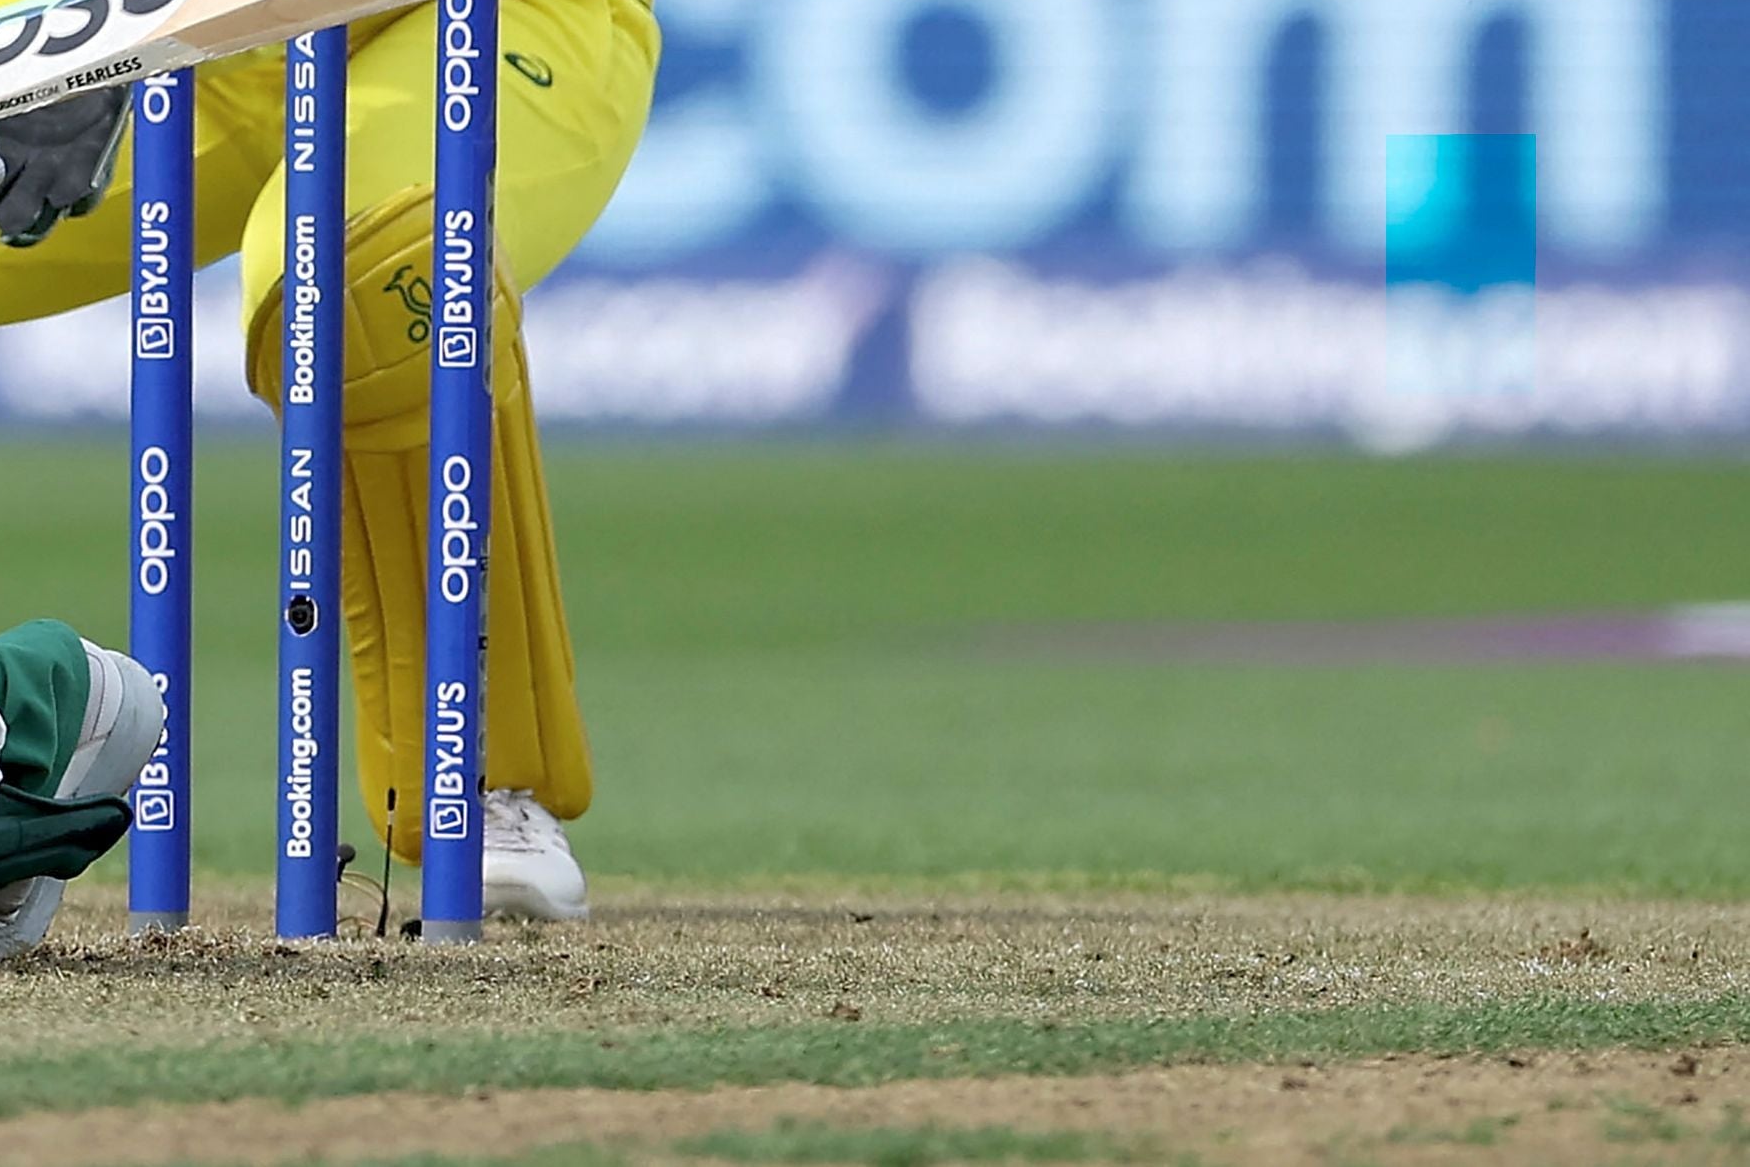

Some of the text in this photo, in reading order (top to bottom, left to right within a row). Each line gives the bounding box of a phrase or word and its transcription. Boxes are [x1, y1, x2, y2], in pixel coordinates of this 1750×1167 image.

[65, 56, 143, 90] FEARLESS
[293, 31, 315, 172] NISSA
[141, 201, 169, 314] BYJU'S
[290, 216, 321, 404] Booking.com
[444, 209, 474, 324] BYJU'S
[140, 446, 175, 594] oppo
[290, 448, 313, 590] ISSAN
[442, 455, 478, 602] oppo
[287, 667, 318, 858] Booking.com
[436, 681, 466, 795] BYJU'S
